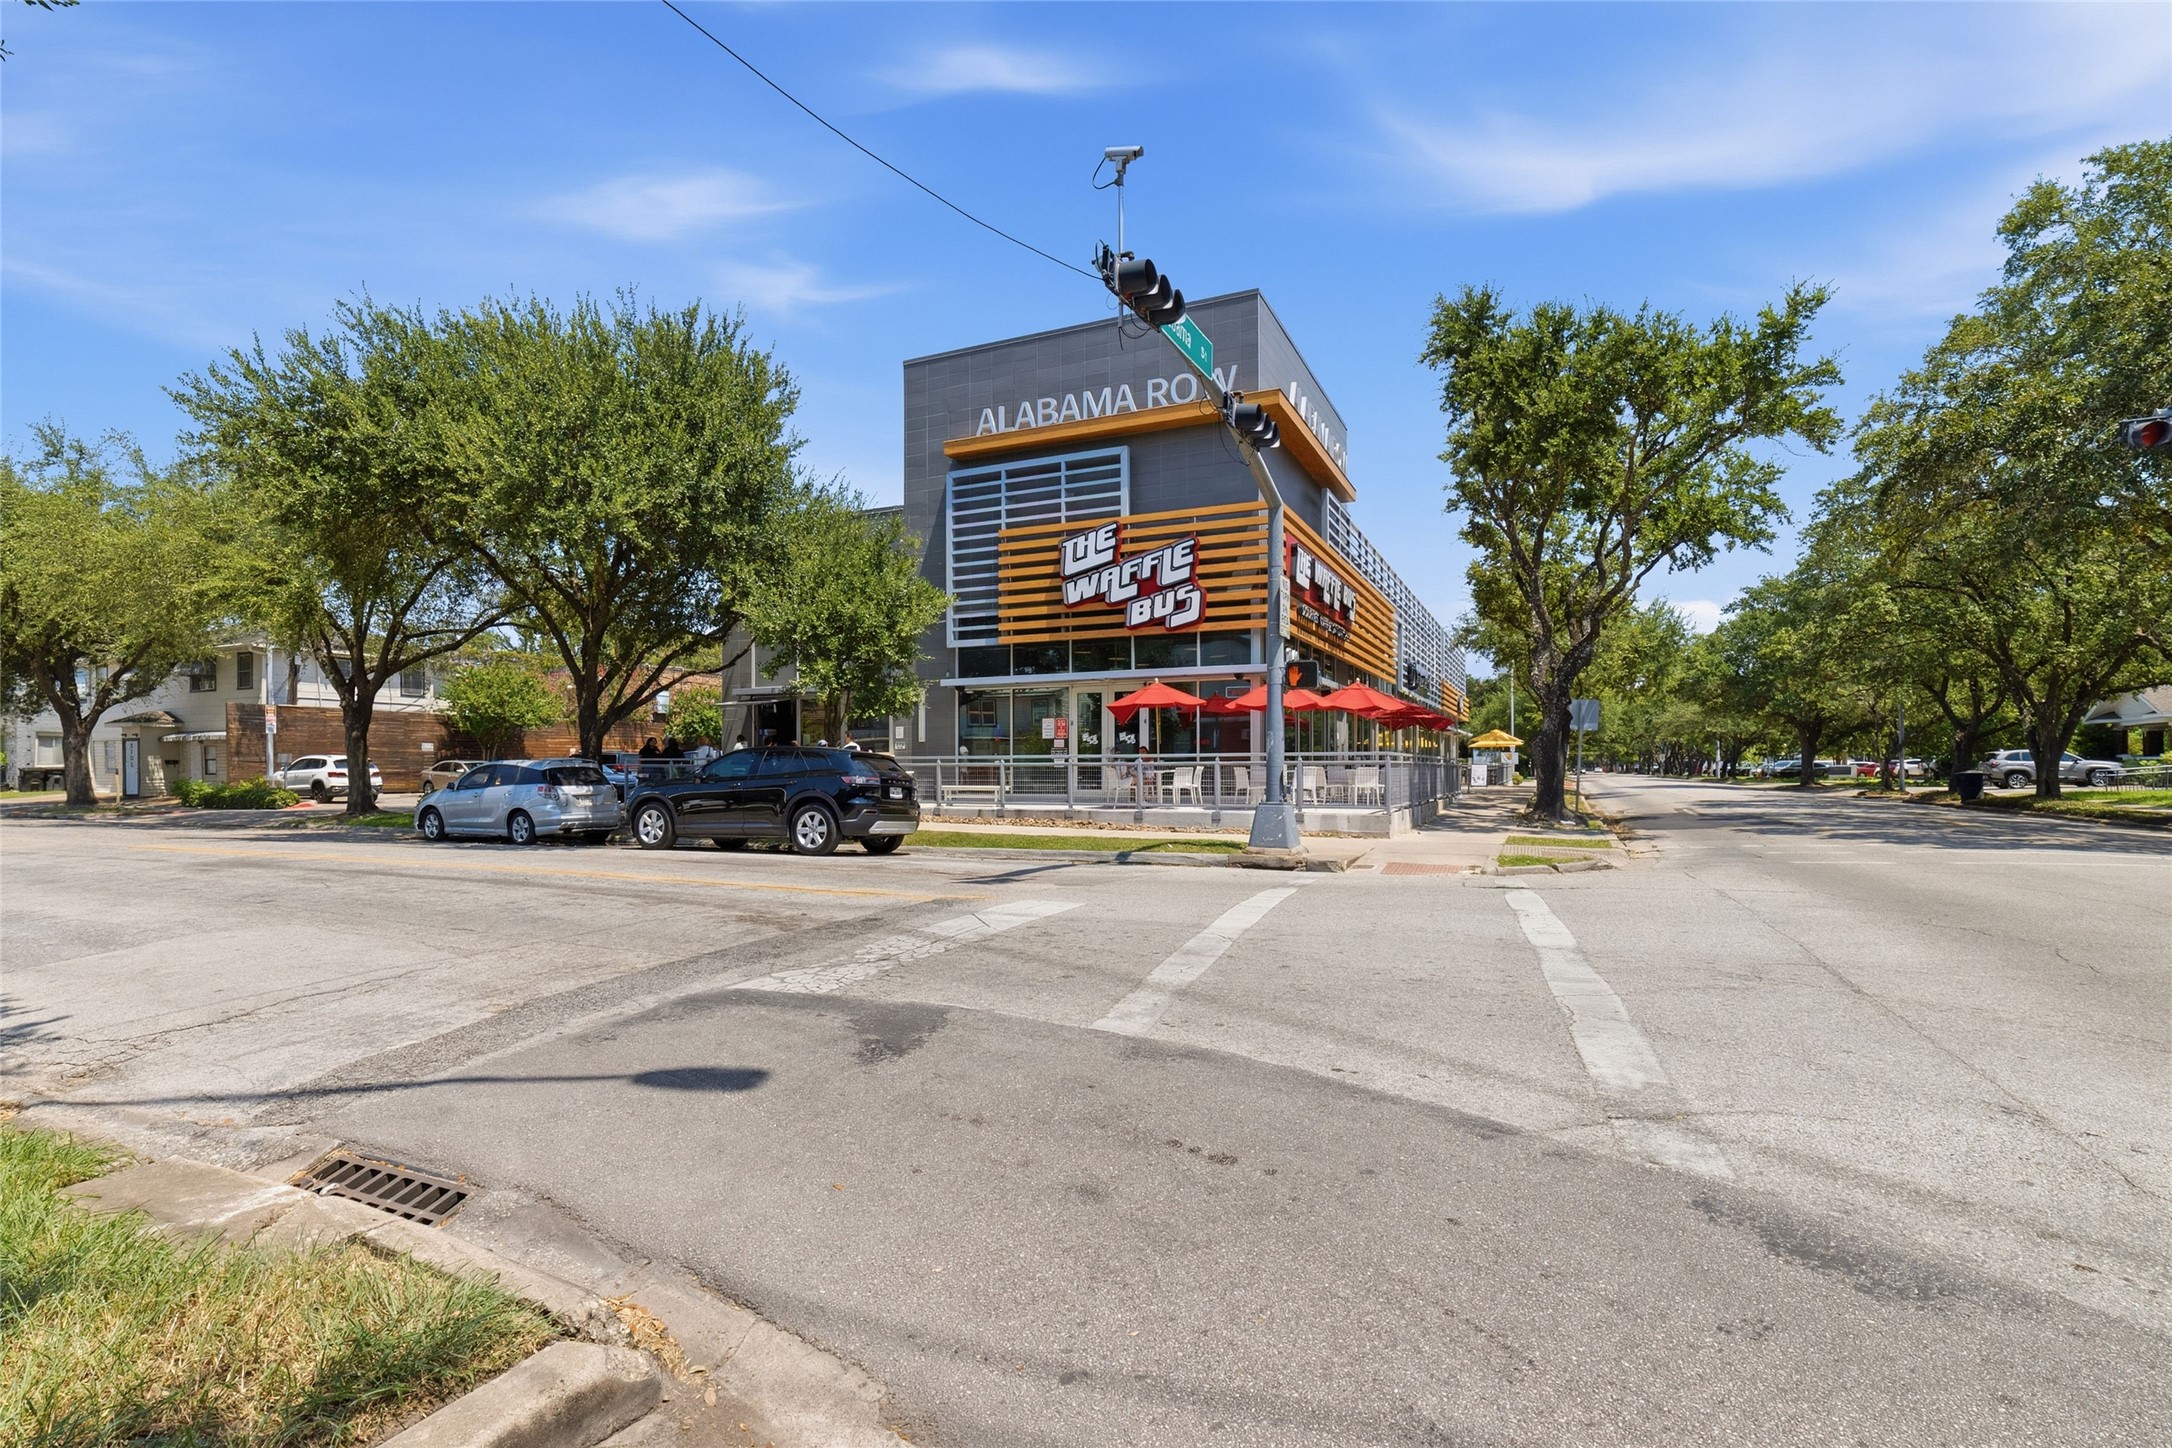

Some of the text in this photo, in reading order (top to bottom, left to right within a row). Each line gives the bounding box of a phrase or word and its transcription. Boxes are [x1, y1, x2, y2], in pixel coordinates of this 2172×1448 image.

[976, 384, 1137, 437] ALABAMA
[1061, 522, 1118, 576] THE
[1064, 538, 1196, 605] WAFFLE
[1295, 545, 1312, 590] THE
[1129, 584, 1202, 628] BUS
